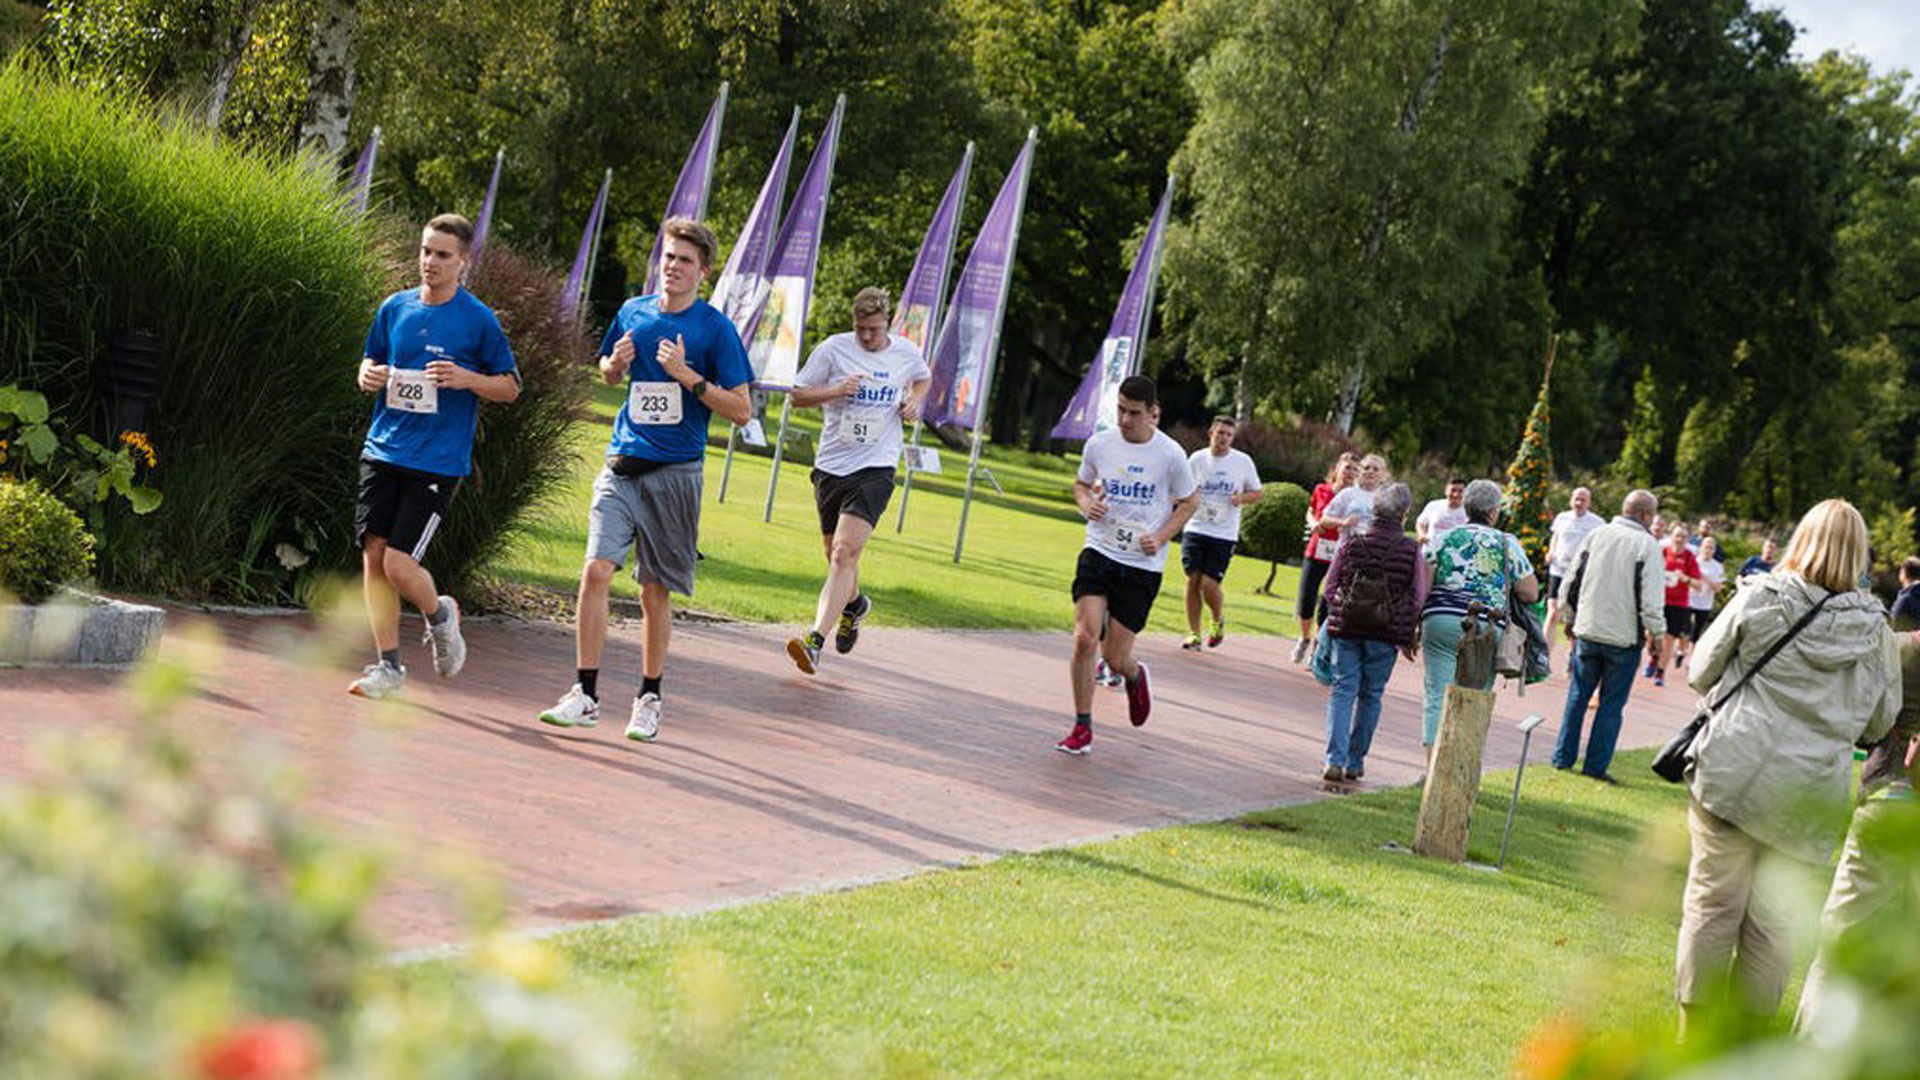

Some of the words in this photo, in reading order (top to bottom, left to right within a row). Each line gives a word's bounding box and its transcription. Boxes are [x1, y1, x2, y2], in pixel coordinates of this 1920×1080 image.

[397, 383, 423, 400] 228
[854, 385, 899, 401] äuft!
[641, 396, 669, 412] 233
[853, 423, 868, 436] 51
[1115, 529, 1133, 543] 54
